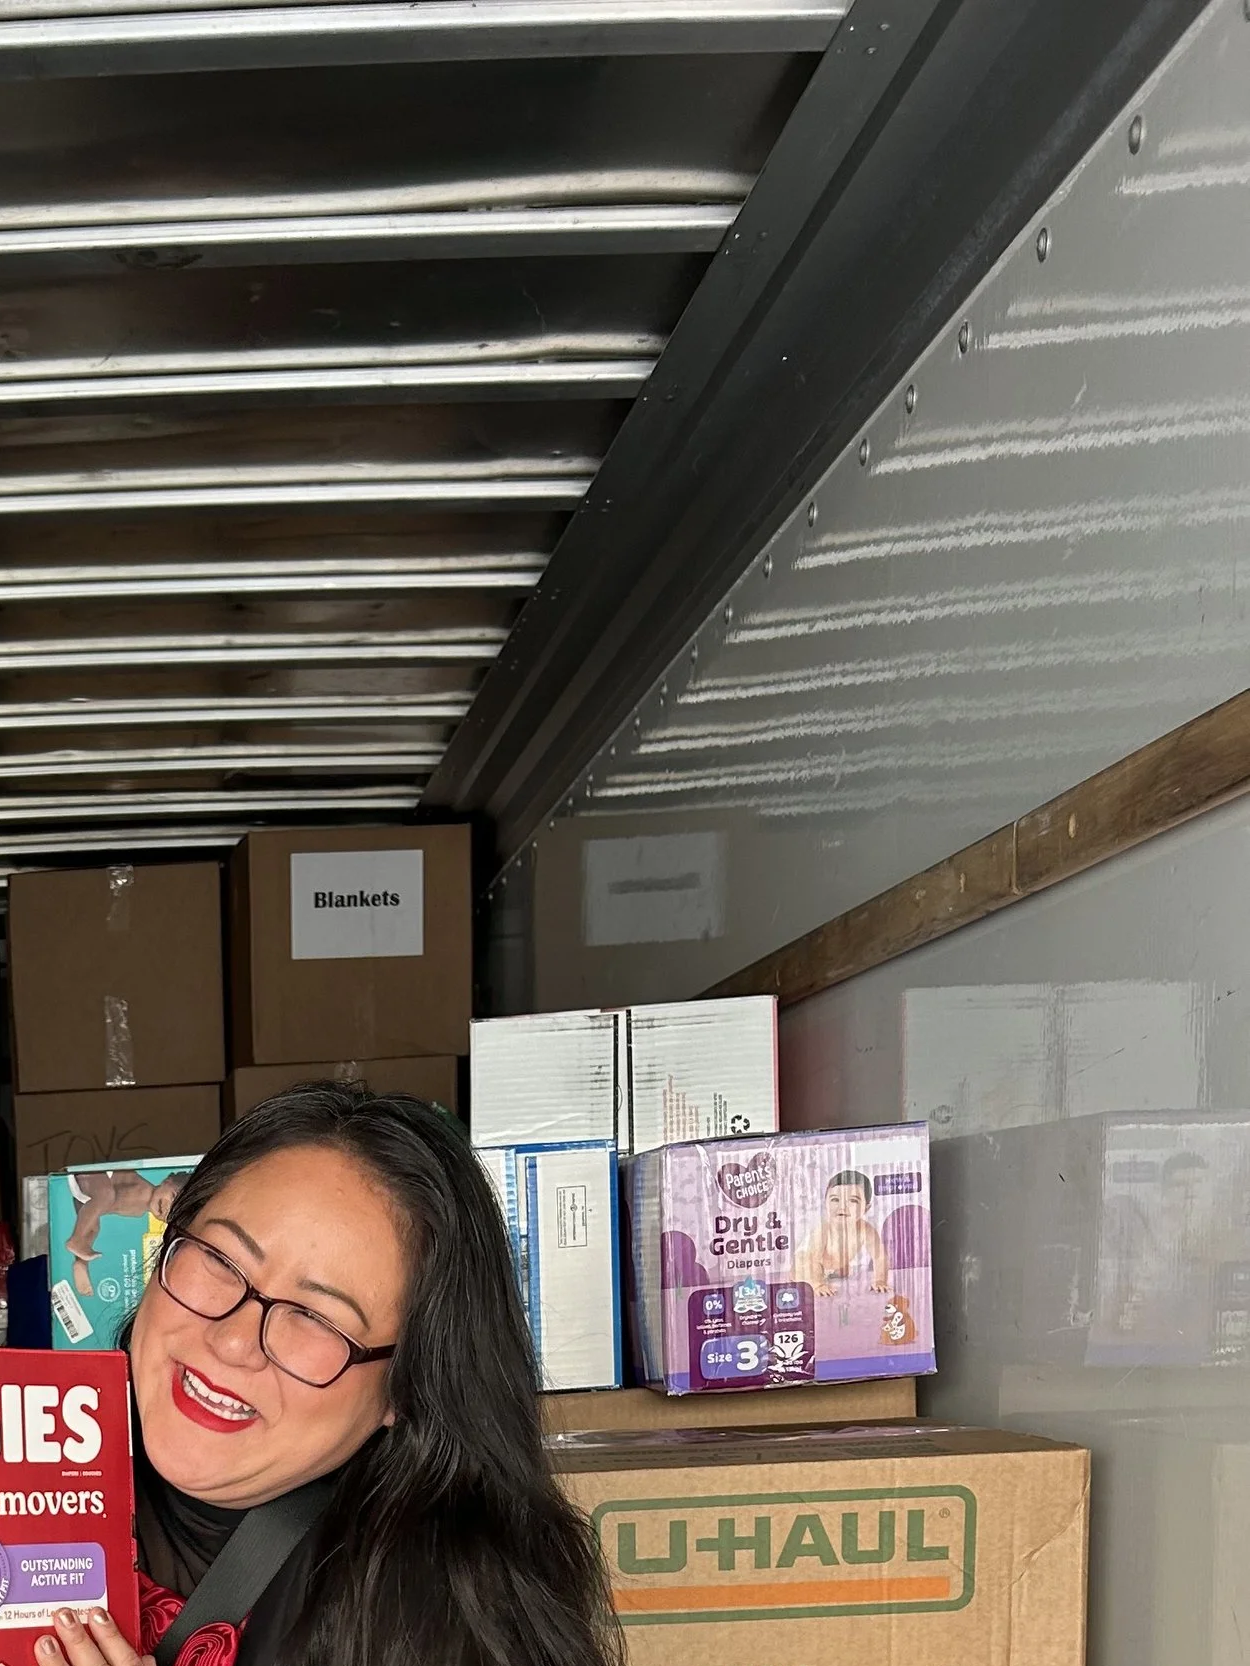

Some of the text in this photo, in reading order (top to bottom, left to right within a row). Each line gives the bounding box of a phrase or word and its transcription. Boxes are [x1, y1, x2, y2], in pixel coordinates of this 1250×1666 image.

[313, 889, 400, 909] Blankets
[725, 1165, 771, 1189] Parent's
[736, 1180, 769, 1199] CHOICE
[715, 1211, 782, 1236] Dry &
[709, 1231, 789, 1256] Gentle
[727, 1257, 771, 1270] Diapers
[705, 1300, 723, 1311] 0%
[778, 1334, 798, 1344] 126
[707, 1341, 758, 1371] Size 3
[617, 1508, 949, 1575] U-HAUL
[21, 1557, 93, 1572] OUTSTANDING
[1, 1578, 10, 1594] FIT
[31, 1572, 85, 1587] ACTIVE FIT
[3, 1607, 45, 1620] 12 Hours of
